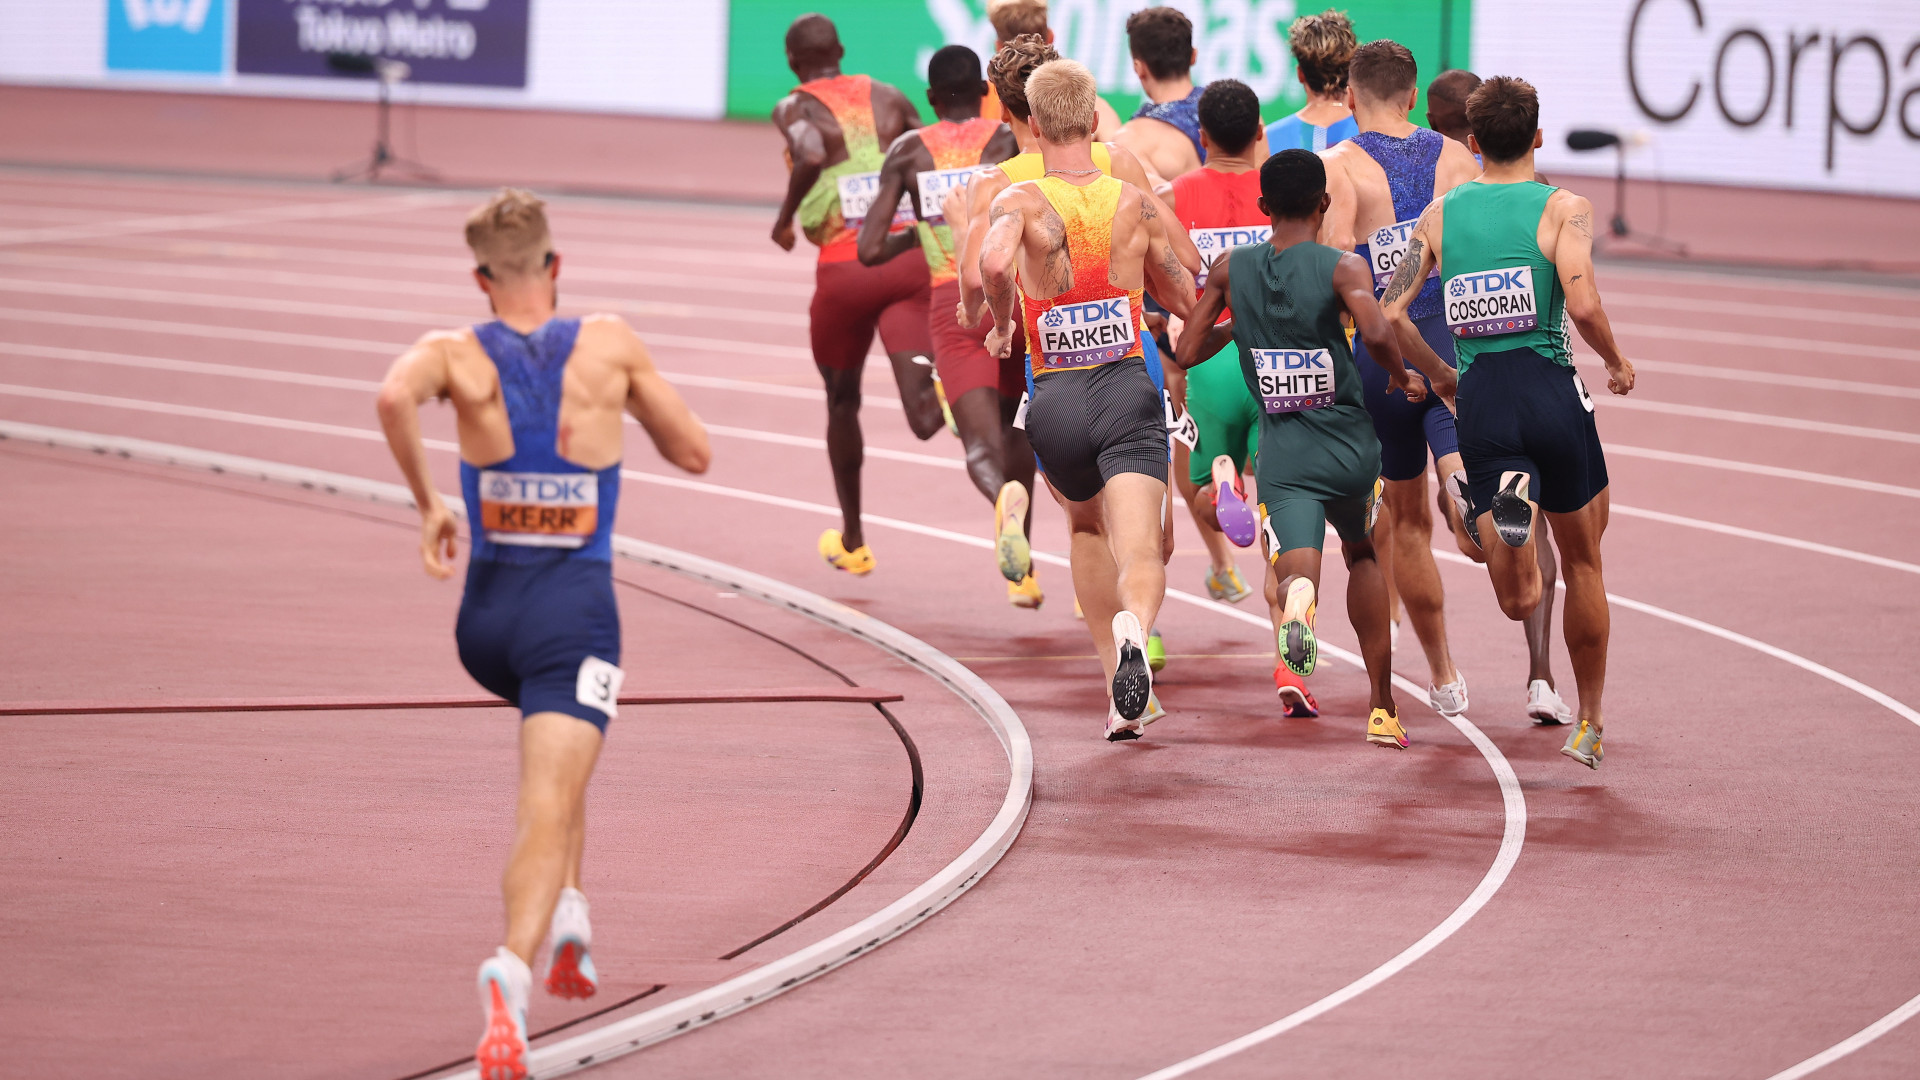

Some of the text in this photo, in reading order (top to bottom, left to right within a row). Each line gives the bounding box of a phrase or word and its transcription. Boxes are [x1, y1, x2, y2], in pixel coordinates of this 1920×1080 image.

[385, 9, 477, 60] Metro
[1214, 229, 1269, 248] TDK
[1465, 270, 1526, 294] TDK
[1062, 300, 1123, 324] TDK
[1449, 293, 1532, 322] COSCORAN
[1045, 322, 1129, 351] FARKEN
[1263, 351, 1327, 370] TDK
[1258, 373, 1329, 395] SHITE
[513, 478, 586, 501] TDK
[499, 505, 578, 530] KERR
